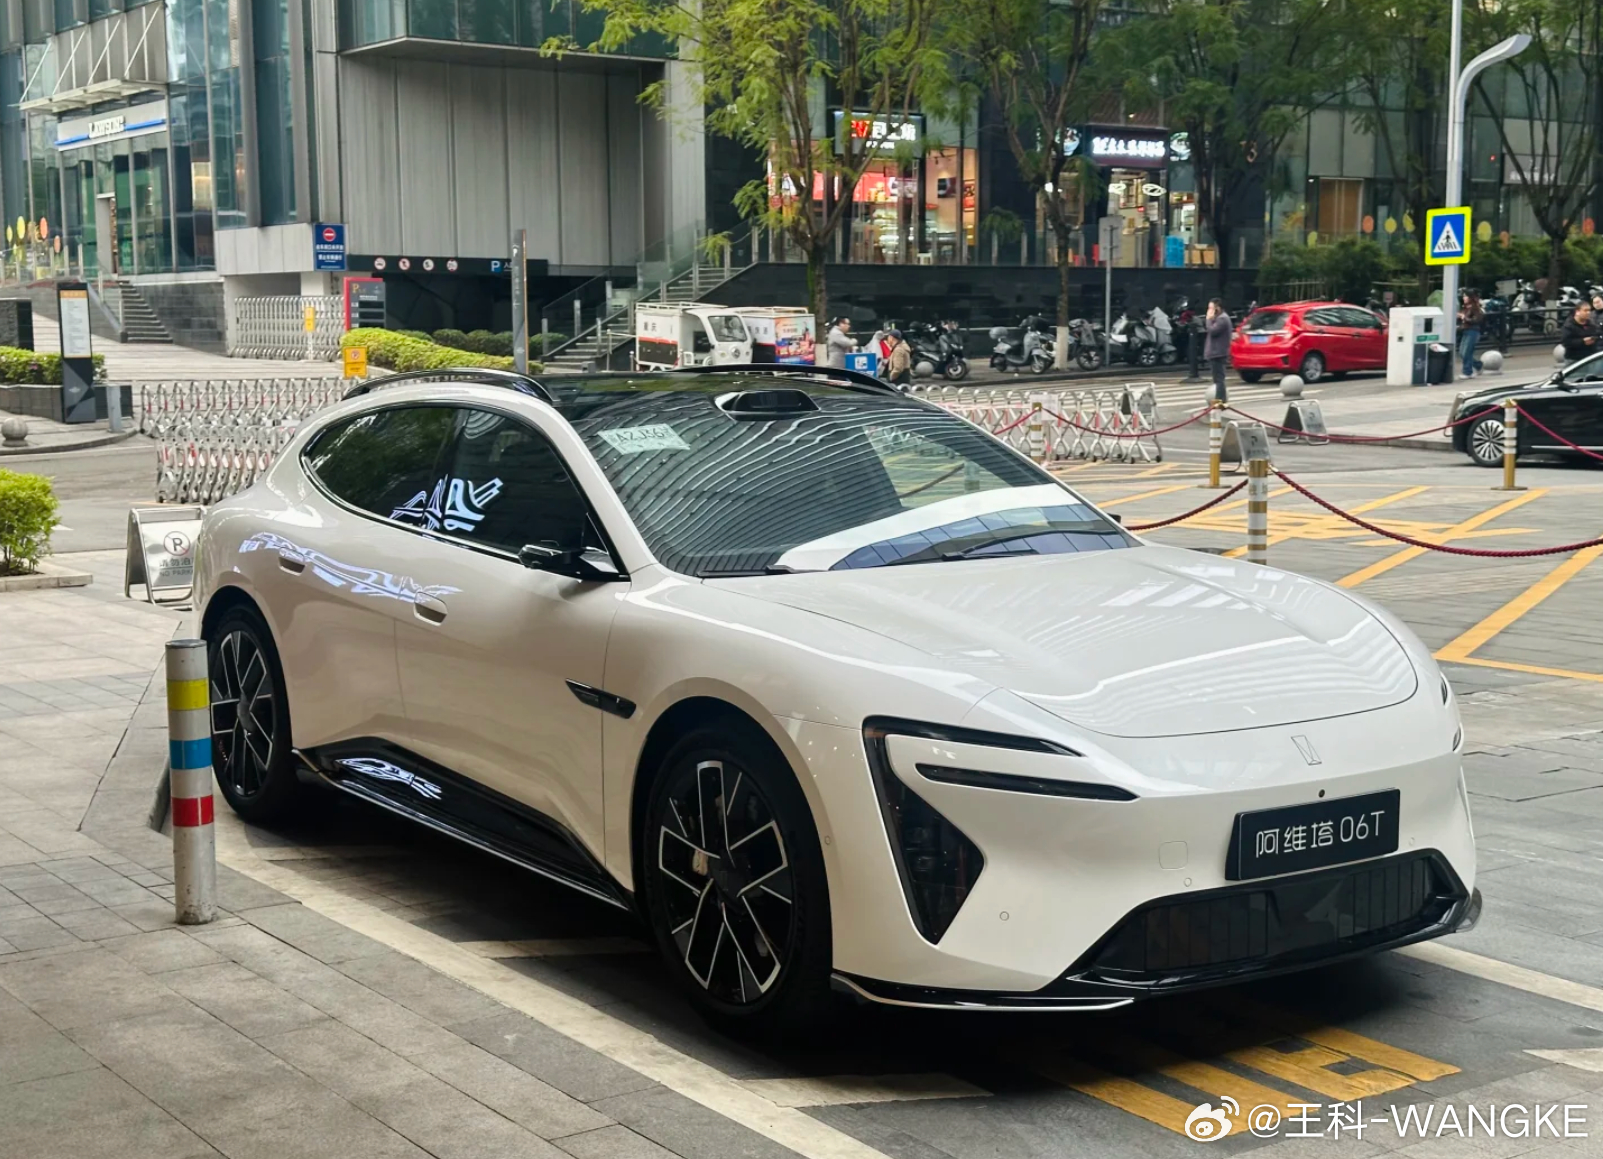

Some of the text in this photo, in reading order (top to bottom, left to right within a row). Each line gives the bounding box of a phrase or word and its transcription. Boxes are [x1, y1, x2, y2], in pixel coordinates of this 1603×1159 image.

[88, 115, 125, 139] LAWSON
[1255, 810, 1385, 859] 阿维塔 06T
